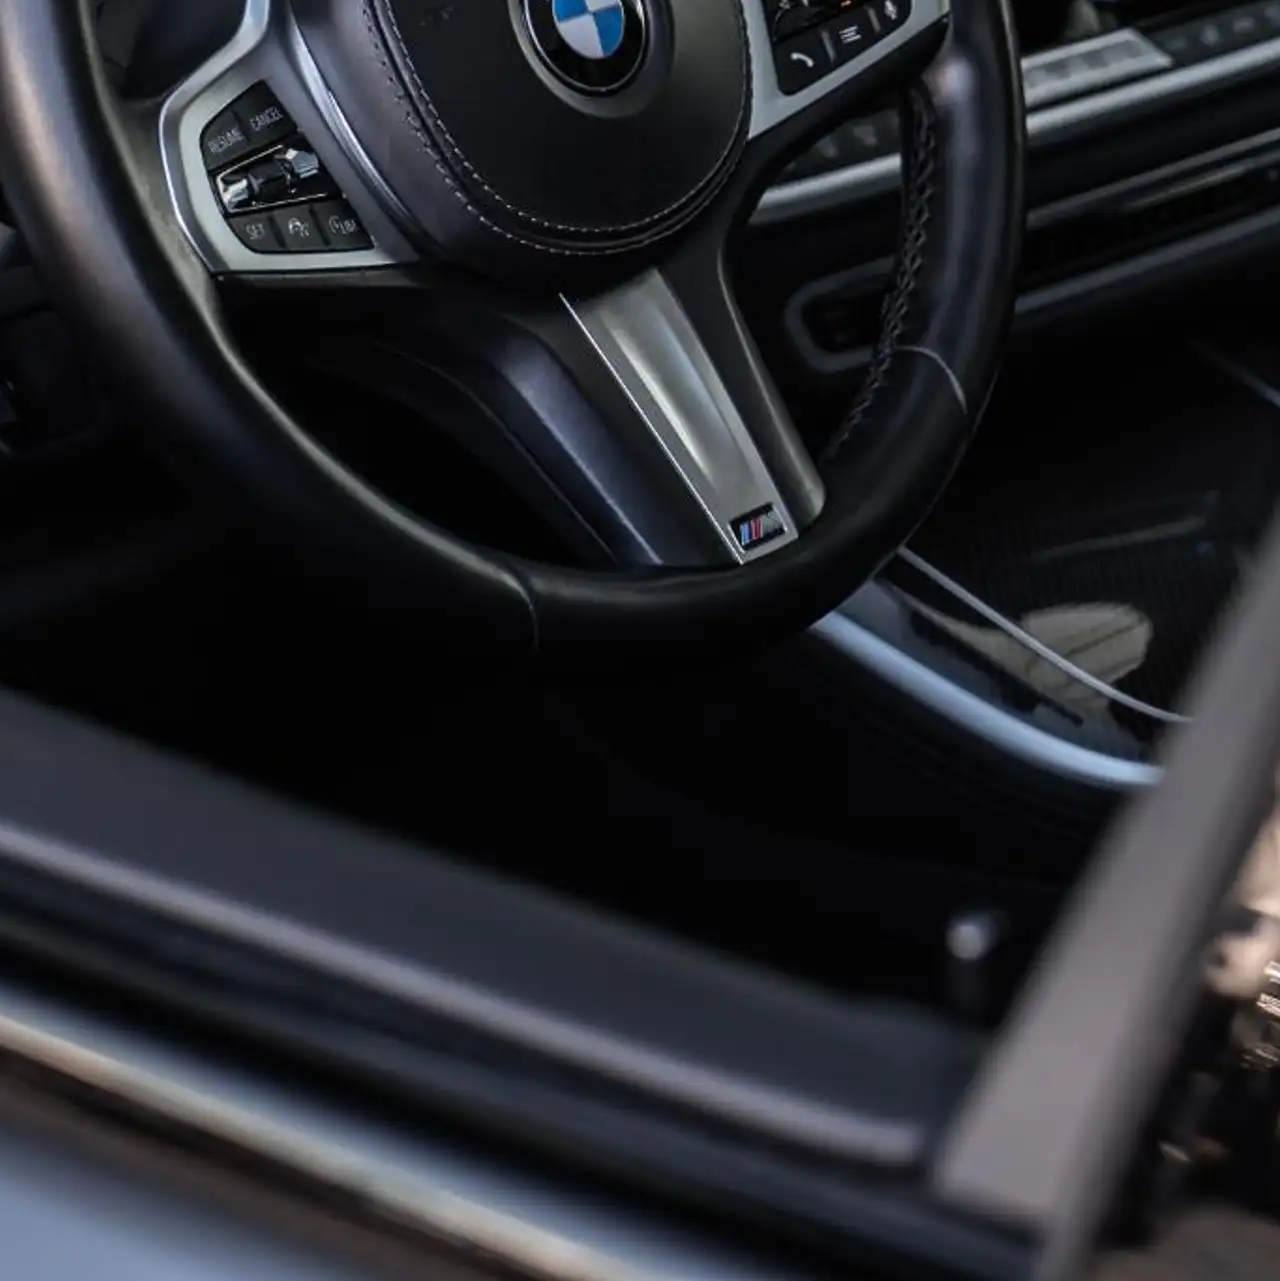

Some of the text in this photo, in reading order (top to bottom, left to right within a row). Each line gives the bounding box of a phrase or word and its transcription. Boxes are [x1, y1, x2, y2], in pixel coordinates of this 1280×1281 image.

[249, 107, 285, 132] CANCEL
[206, 127, 246, 154] RESUME
[246, 223, 265, 240] SET
